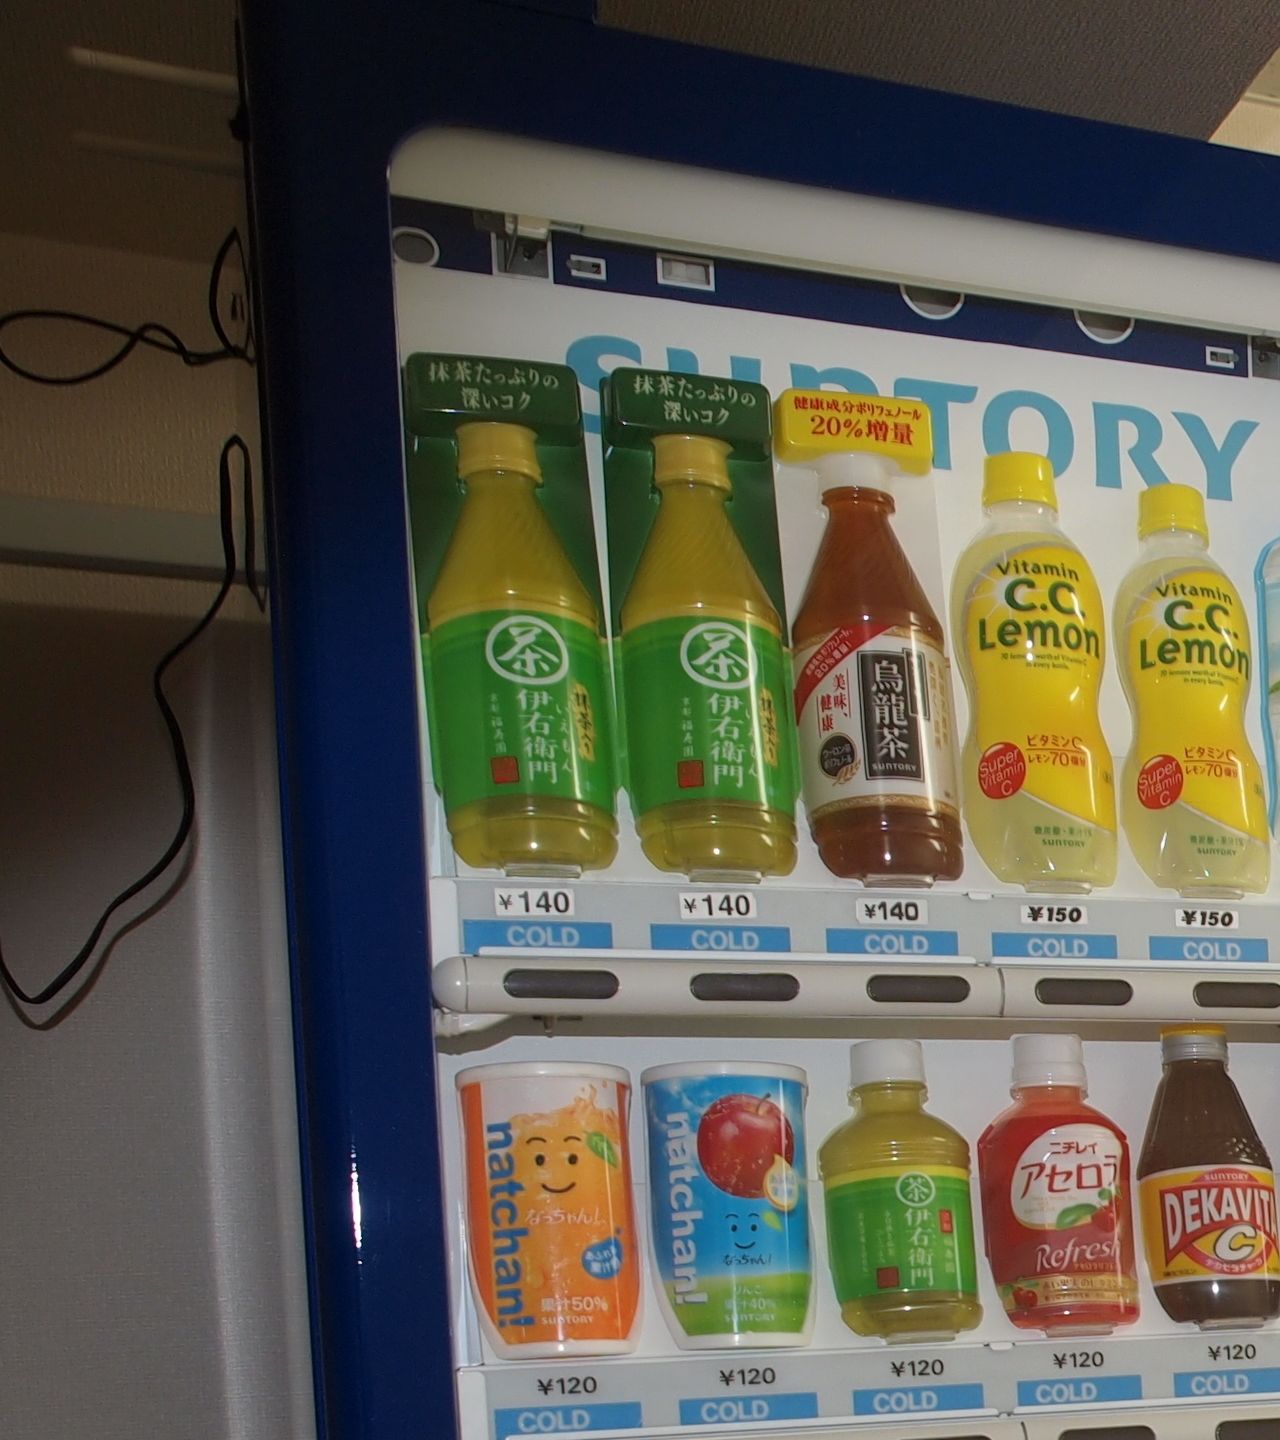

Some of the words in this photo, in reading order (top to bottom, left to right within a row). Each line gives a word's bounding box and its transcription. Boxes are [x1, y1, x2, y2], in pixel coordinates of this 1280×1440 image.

[429, 360, 559, 391] 抹茶たっぷりの
[461, 388, 531, 410] 深いコク
[633, 374, 756, 408] 抹茶たっぷりの
[663, 400, 731, 425] 深いコク
[810, 415, 914, 446] 20%増量
[996, 559, 1079, 582] Vitamin
[1156, 585, 1233, 605] Vitamin
[979, 618, 1100, 660] Lemon
[498, 626, 560, 676] 茶
[690, 632, 748, 681] 茶
[1139, 637, 1250, 681] Lemon
[873, 660, 909, 760] 烏龍茶
[516, 688, 559, 785] 伊右衛門
[707, 692, 744, 788] 伊右衛門
[1027, 735, 1083, 747] ビタミンC
[979, 749, 1018, 778] Super
[1184, 747, 1235, 761] ビタミンC
[872, 762, 917, 772] SUNTORY
[981, 761, 1024, 792] Vitamin
[1138, 760, 1178, 789] Super
[1140, 772, 1183, 801] Vitamin
[499, 892, 570, 914] ¥140
[684, 895, 751, 917] ¥140
[864, 902, 919, 921] ¥140
[1027, 907, 1082, 923] ¥150
[1181, 911, 1233, 928] ¥150
[507, 926, 580, 947] COLD
[691, 930, 760, 951] COLD
[864, 934, 928, 953] COLD
[1027, 939, 1088, 957] COLD
[1183, 942, 1241, 960] COLD
[1050, 1140, 1099, 1157] ニチレイ
[1204, 1172, 1248, 1182] SUNTORY
[902, 1176, 930, 1203] 茶
[667, 1111, 708, 1307] natchan!
[486, 1121, 539, 1328] natchan!
[905, 1208, 935, 1288] 伊右衛門
[1214, 1224, 1257, 1261] C
[540, 1297, 609, 1313] 果汁50%
[541, 1314, 594, 1326] SUNTORY
[1053, 1352, 1104, 1369] ¥120
[1208, 1344, 1256, 1361] ¥120
[719, 1368, 776, 1386] ¥120
[891, 1359, 944, 1378] ¥120
[537, 1377, 597, 1396] ¥120
[1035, 1383, 1098, 1403] COLD
[1191, 1376, 1249, 1395] COLD
[701, 1401, 770, 1423] COLD
[873, 1392, 938, 1413] COLD
[518, 1410, 590, 1433] COLD
